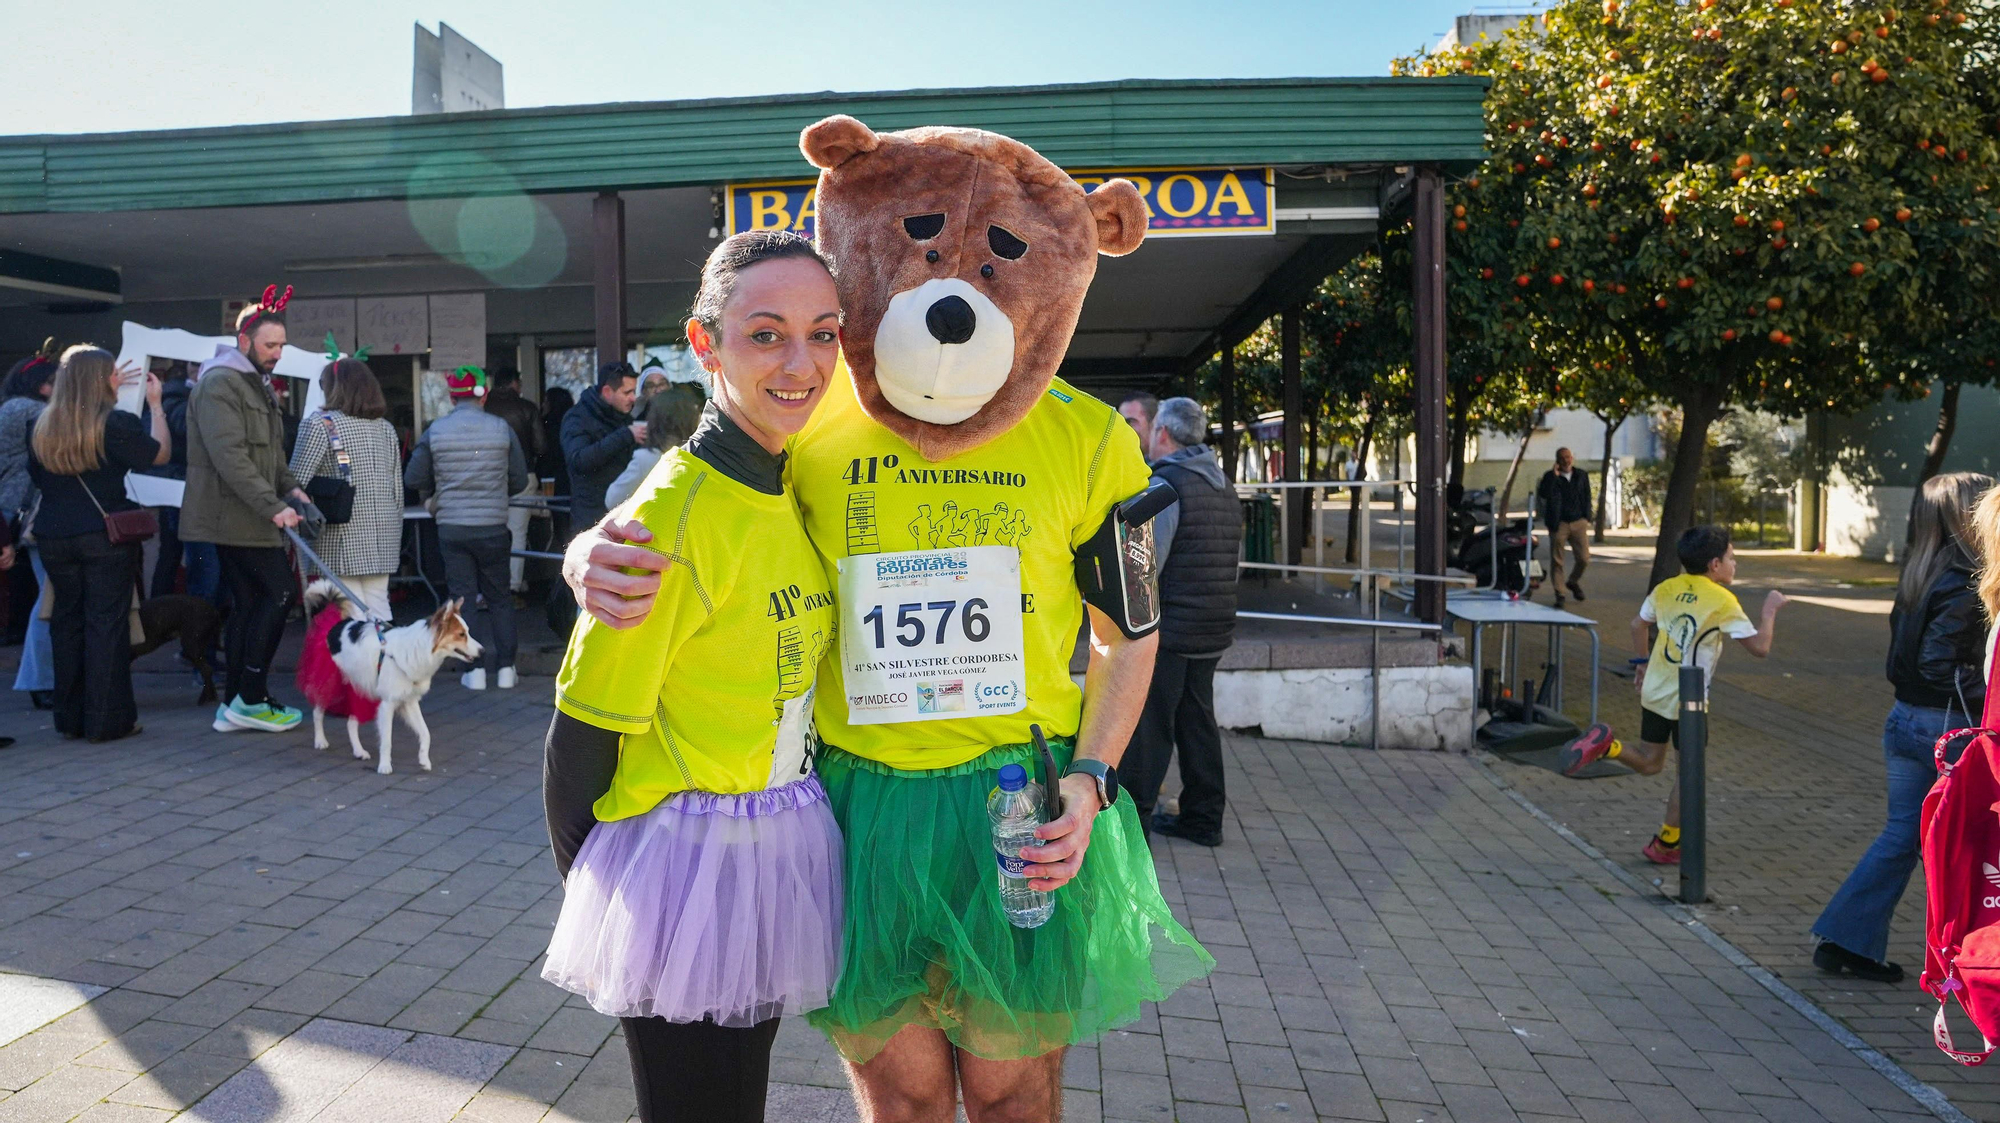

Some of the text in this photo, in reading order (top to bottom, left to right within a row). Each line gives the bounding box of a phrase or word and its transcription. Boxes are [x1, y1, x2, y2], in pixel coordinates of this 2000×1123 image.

[842, 454, 1026, 488] 41º ANIVERSARIO
[876, 556, 953, 569] carreras
[877, 560, 968, 576] populares
[877, 573, 920, 581] Diputación
[863, 597, 991, 649] 1576
[867, 662, 886, 671] SAN
[889, 657, 950, 670] SILVESTRE
[952, 653, 1018, 665] CORDOBESA
[889, 671, 907, 680] JOSÉ
[908, 670, 936, 678] JAVIER
[959, 667, 986, 675] GÓMEZ
[983, 685, 1009, 696] GCC
[864, 692, 908, 705] IMDECO
[1005, 859, 1024, 868] Font
